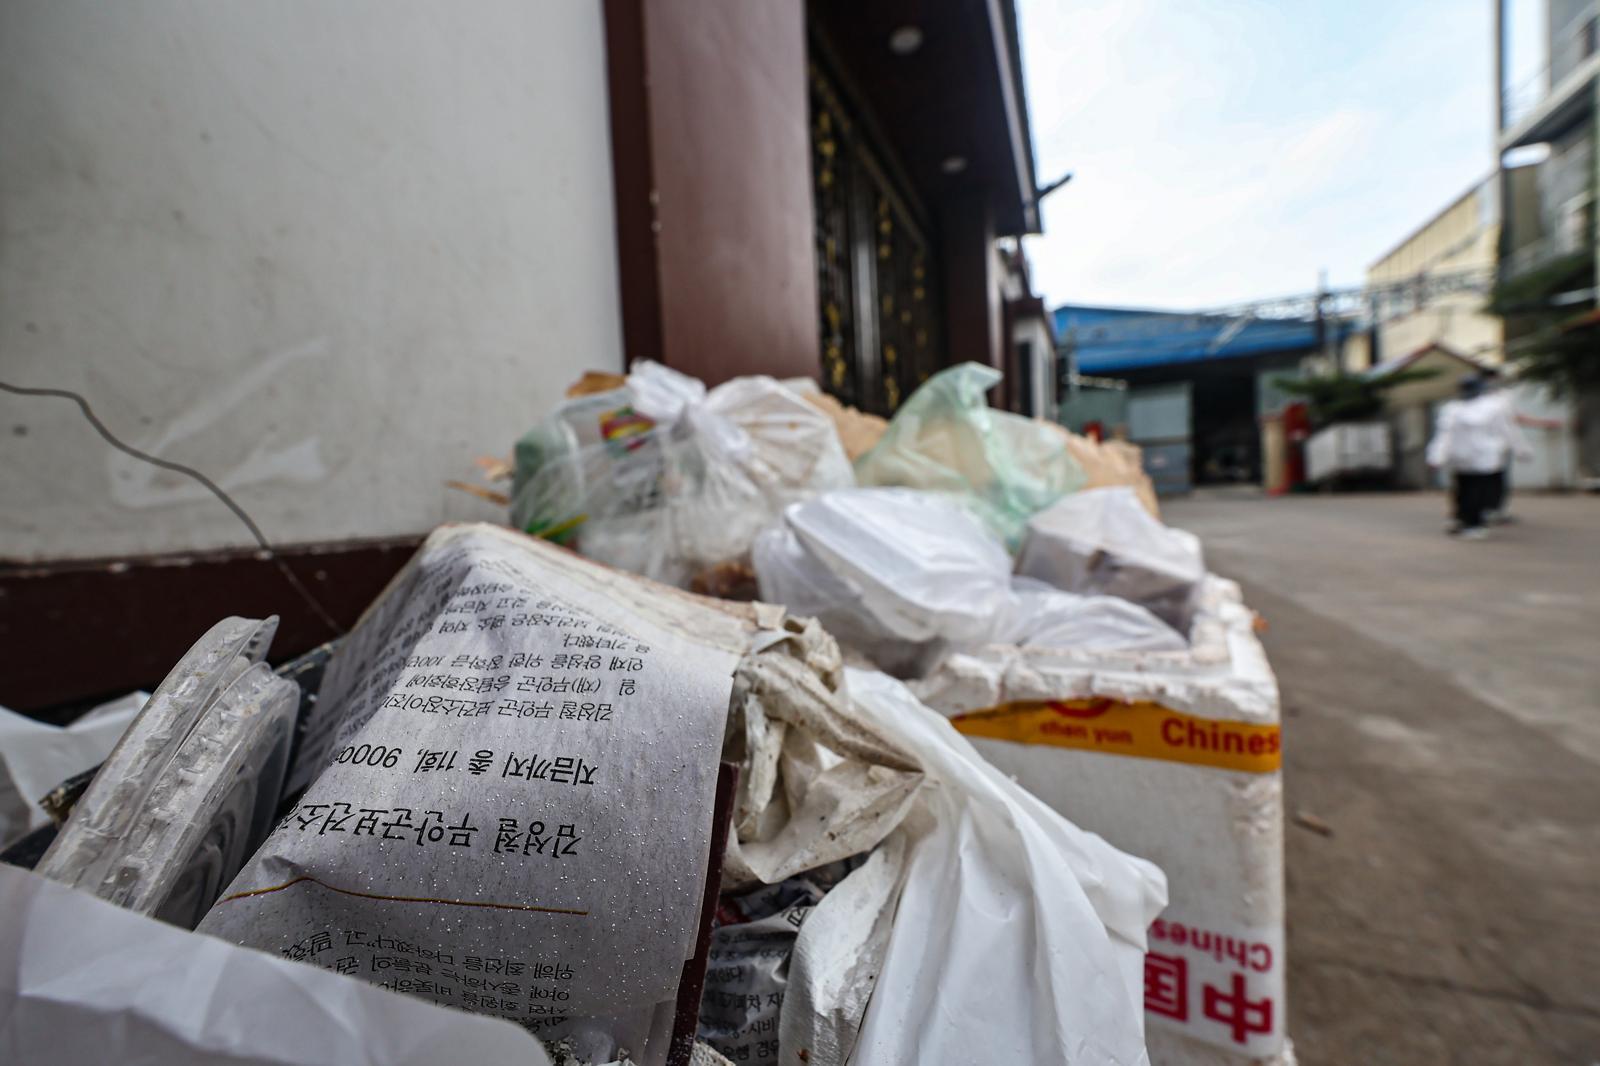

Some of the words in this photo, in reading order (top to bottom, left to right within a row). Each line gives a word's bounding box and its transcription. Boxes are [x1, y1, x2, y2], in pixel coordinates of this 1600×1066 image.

[438, 621, 472, 634] 지역
[450, 654, 503, 671] 장학금
[509, 653, 543, 668] 위한
[551, 654, 601, 670] 양성을
[608, 656, 644, 672] 인재
[517, 675, 601, 694] (재)무안군
[619, 679, 636, 696] 일
[498, 699, 553, 720] 무안군
[558, 701, 613, 722] 김성철
[1161, 718, 1280, 756] Chines
[333, 744, 402, 769] 9000
[413, 748, 458, 774] 11회,
[468, 750, 494, 775] 총
[501, 751, 599, 786] 지금까지
[493, 818, 582, 859] 김성철
[1151, 919, 1272, 974] Chines
[371, 955, 434, 975] 분들의
[463, 955, 525, 977] 최선을
[533, 963, 575, 980] 위해
[441, 969, 522, 996] 종사하는
[462, 991, 519, 1013] 회원을
